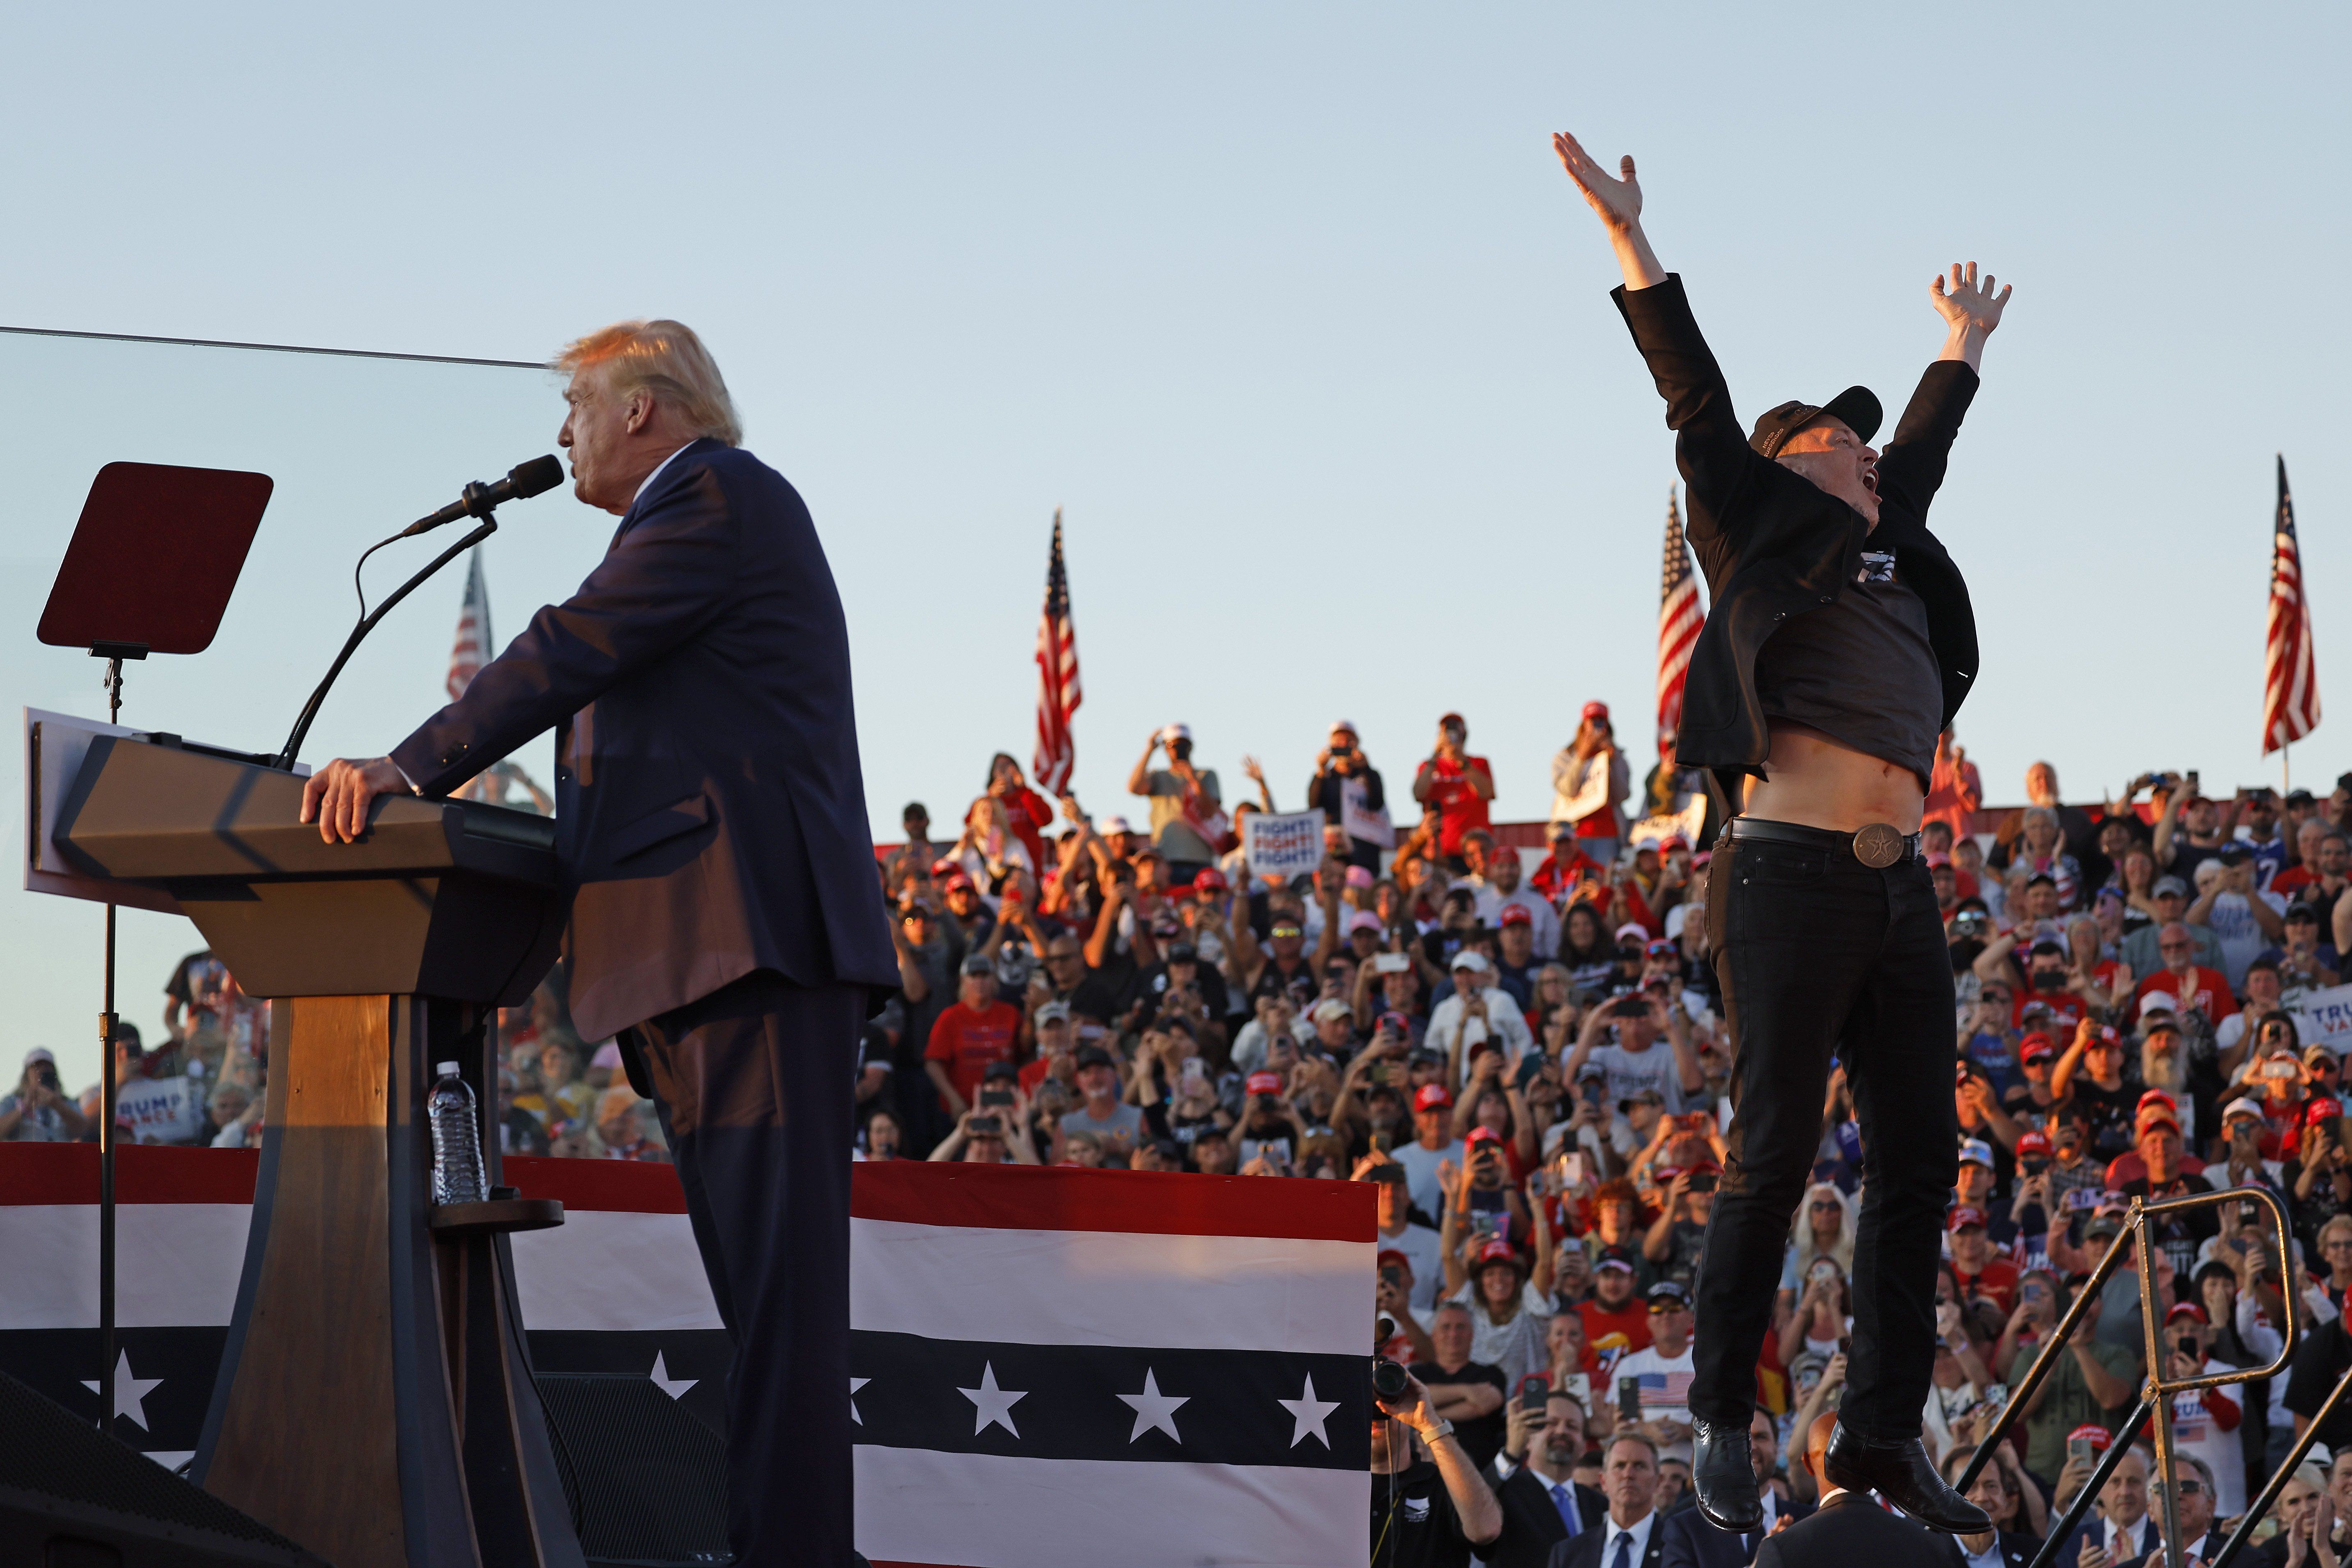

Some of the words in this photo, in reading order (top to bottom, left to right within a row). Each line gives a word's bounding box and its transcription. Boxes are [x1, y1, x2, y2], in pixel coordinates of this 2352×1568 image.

[1762, 431, 1775, 449] NEVER
[1763, 427, 1784, 457] SURRENDER
[1254, 820, 1313, 834] FIGHT!
[1254, 834, 1314, 848] FIGHT!
[1255, 850, 1315, 864] FIGHT!
[2324, 1018, 2352, 1033] VA
[118, 1092, 180, 1115] RUMP
